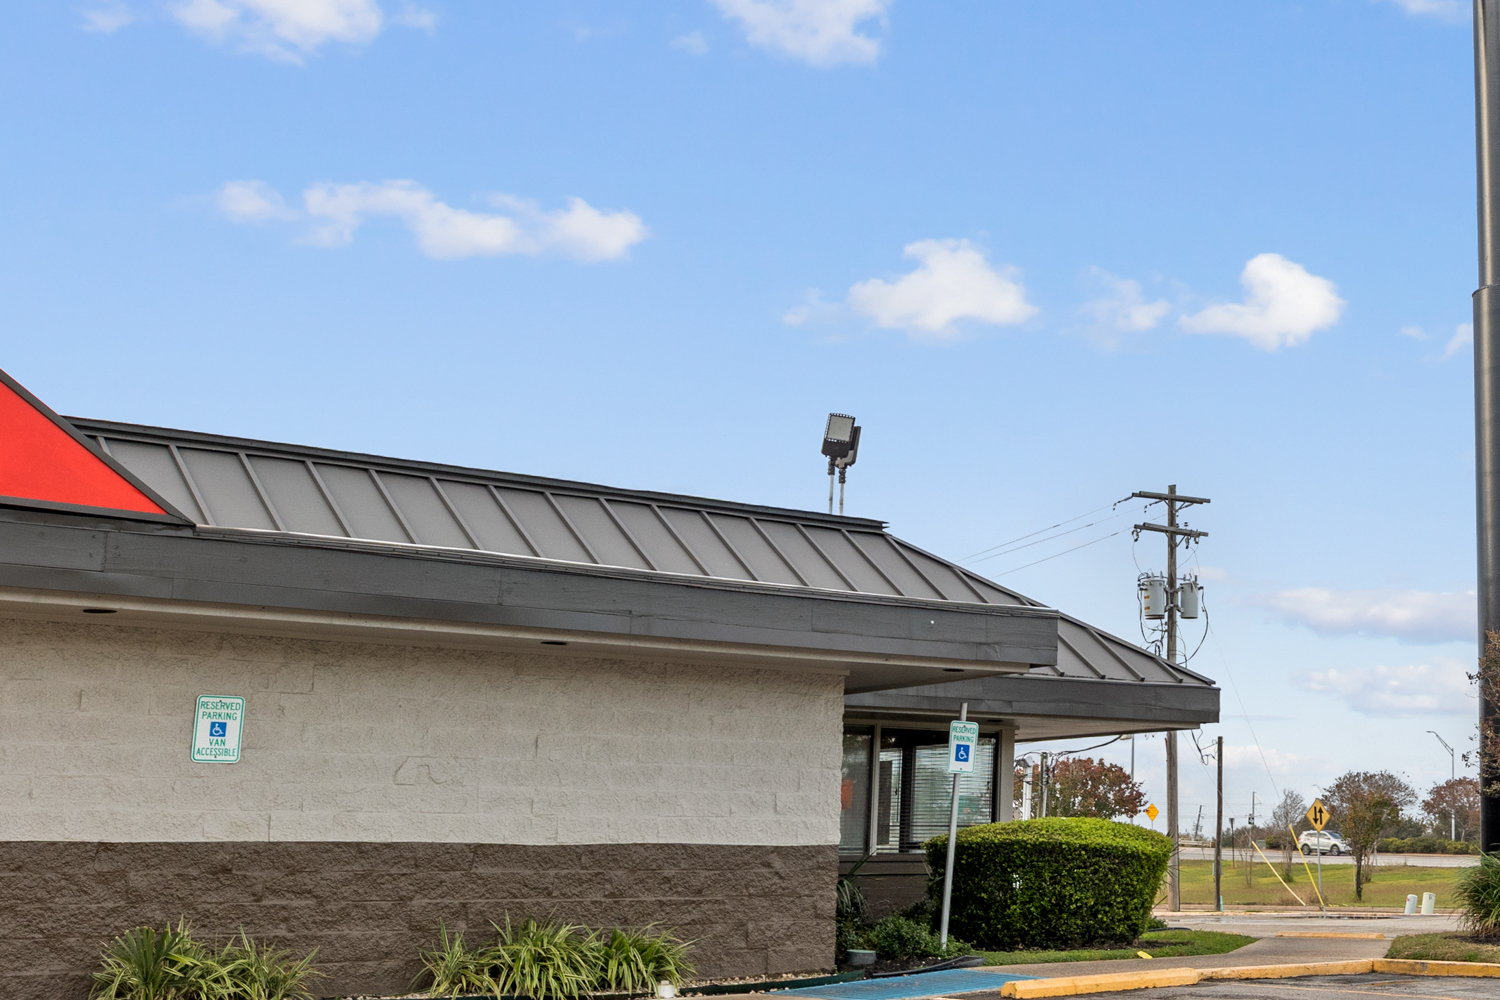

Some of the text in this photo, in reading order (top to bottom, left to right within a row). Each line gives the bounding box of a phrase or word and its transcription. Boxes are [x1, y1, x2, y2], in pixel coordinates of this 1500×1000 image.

[200, 701, 241, 711] RESERVED
[201, 711, 238, 721] PARKING
[952, 725, 976, 735] RESERVED
[208, 738, 226, 747] VAN
[953, 734, 974, 743] PARKING
[196, 747, 236, 757] ACCESSIBLE
